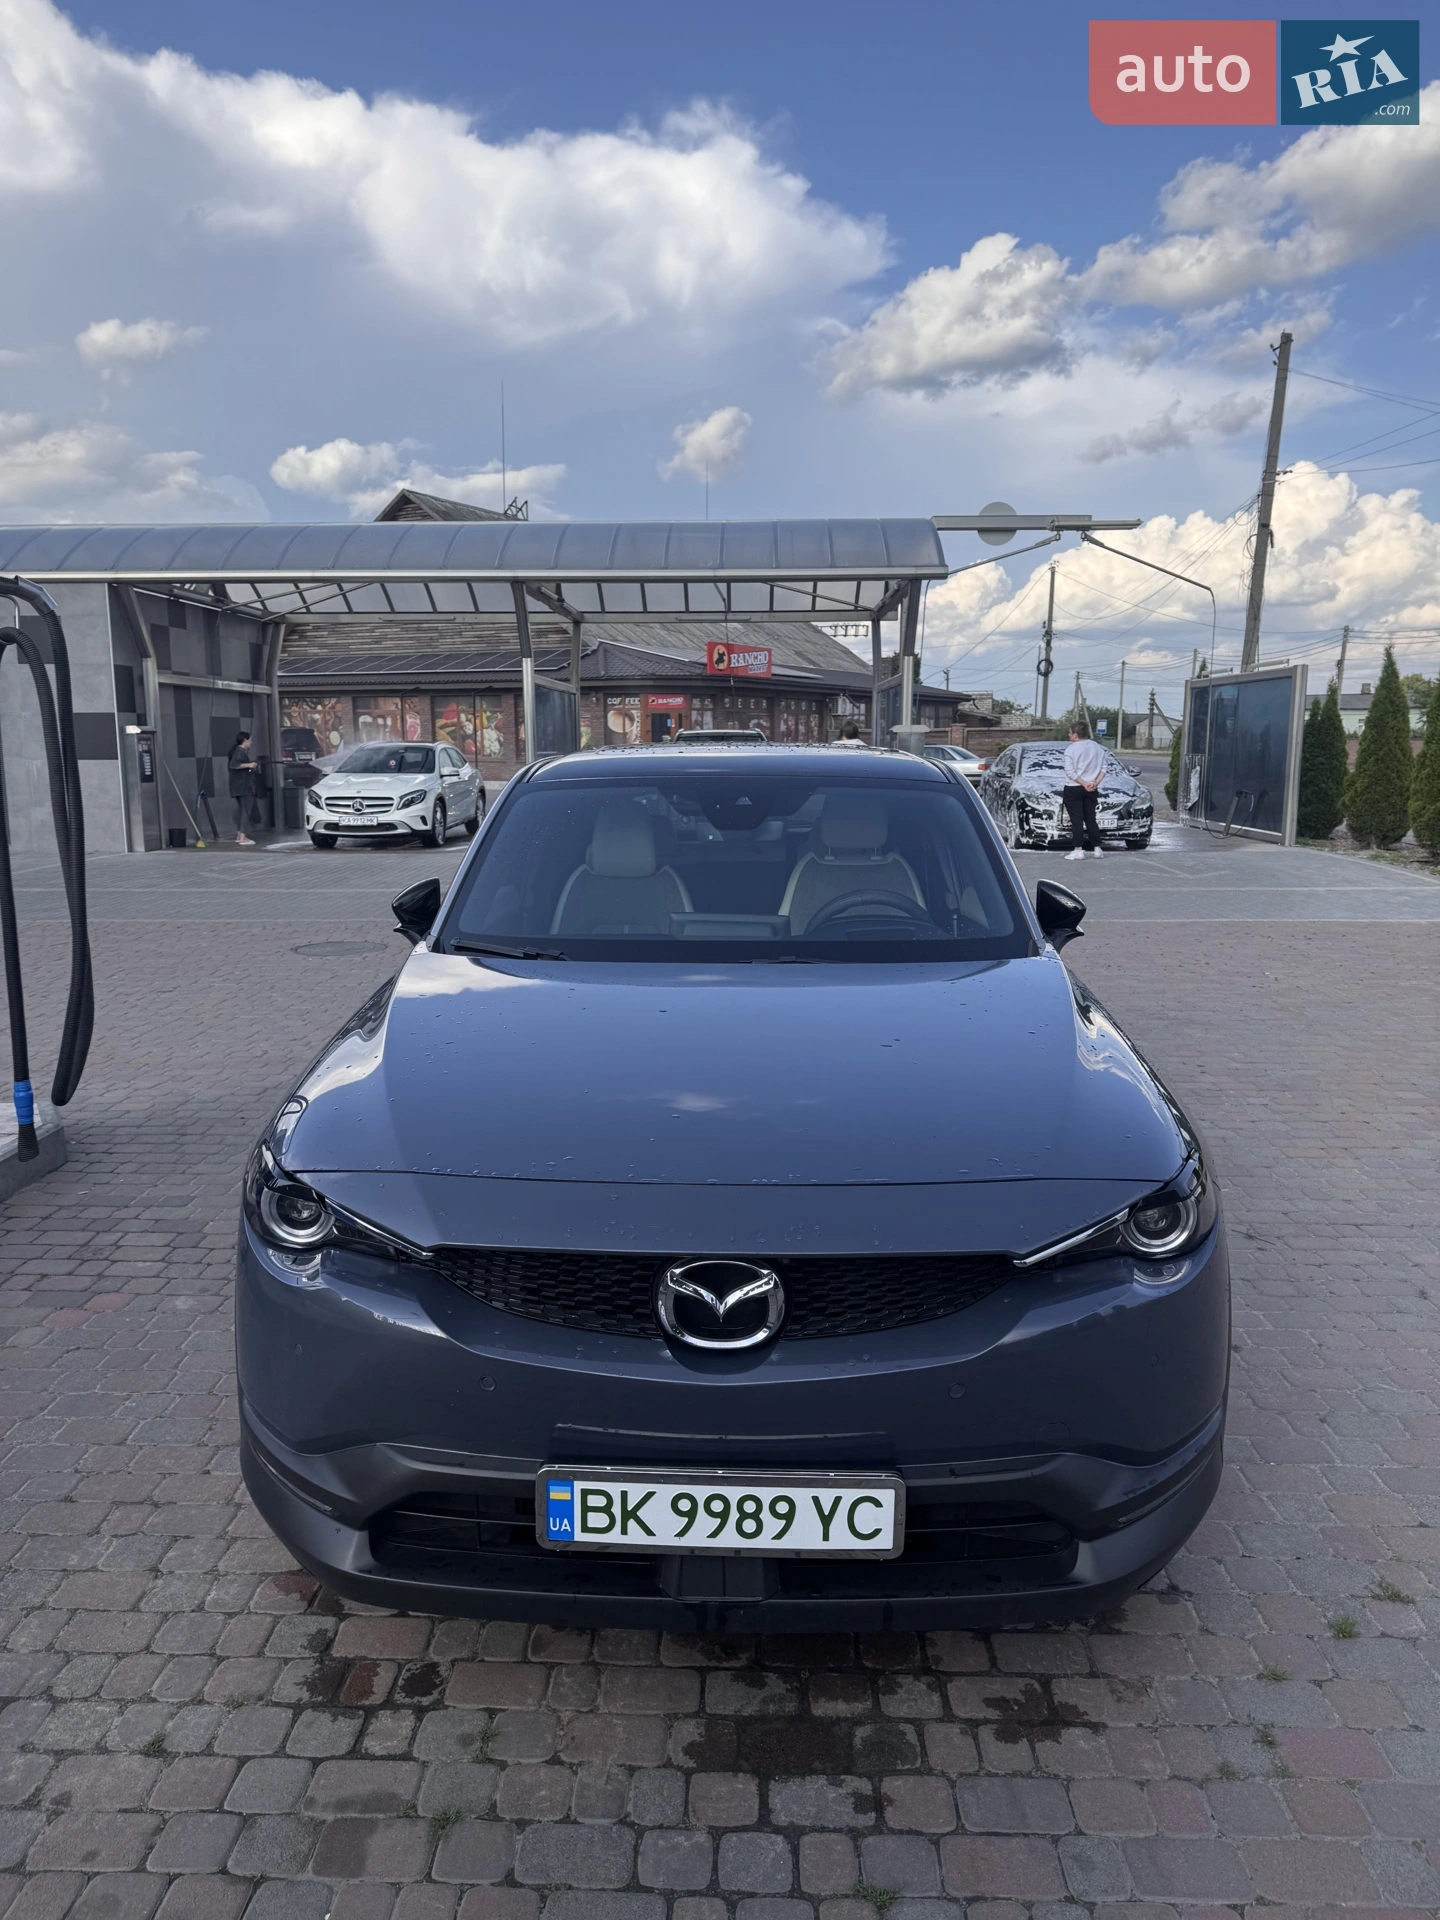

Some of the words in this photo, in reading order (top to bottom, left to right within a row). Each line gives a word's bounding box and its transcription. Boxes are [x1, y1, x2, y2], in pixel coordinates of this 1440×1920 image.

[730, 651, 769, 668] RANCHO
[580, 1488, 657, 1537] BK
[670, 1492, 797, 1541] 9989
[811, 1495, 884, 1542] YC
[549, 1517, 571, 1532] UA
